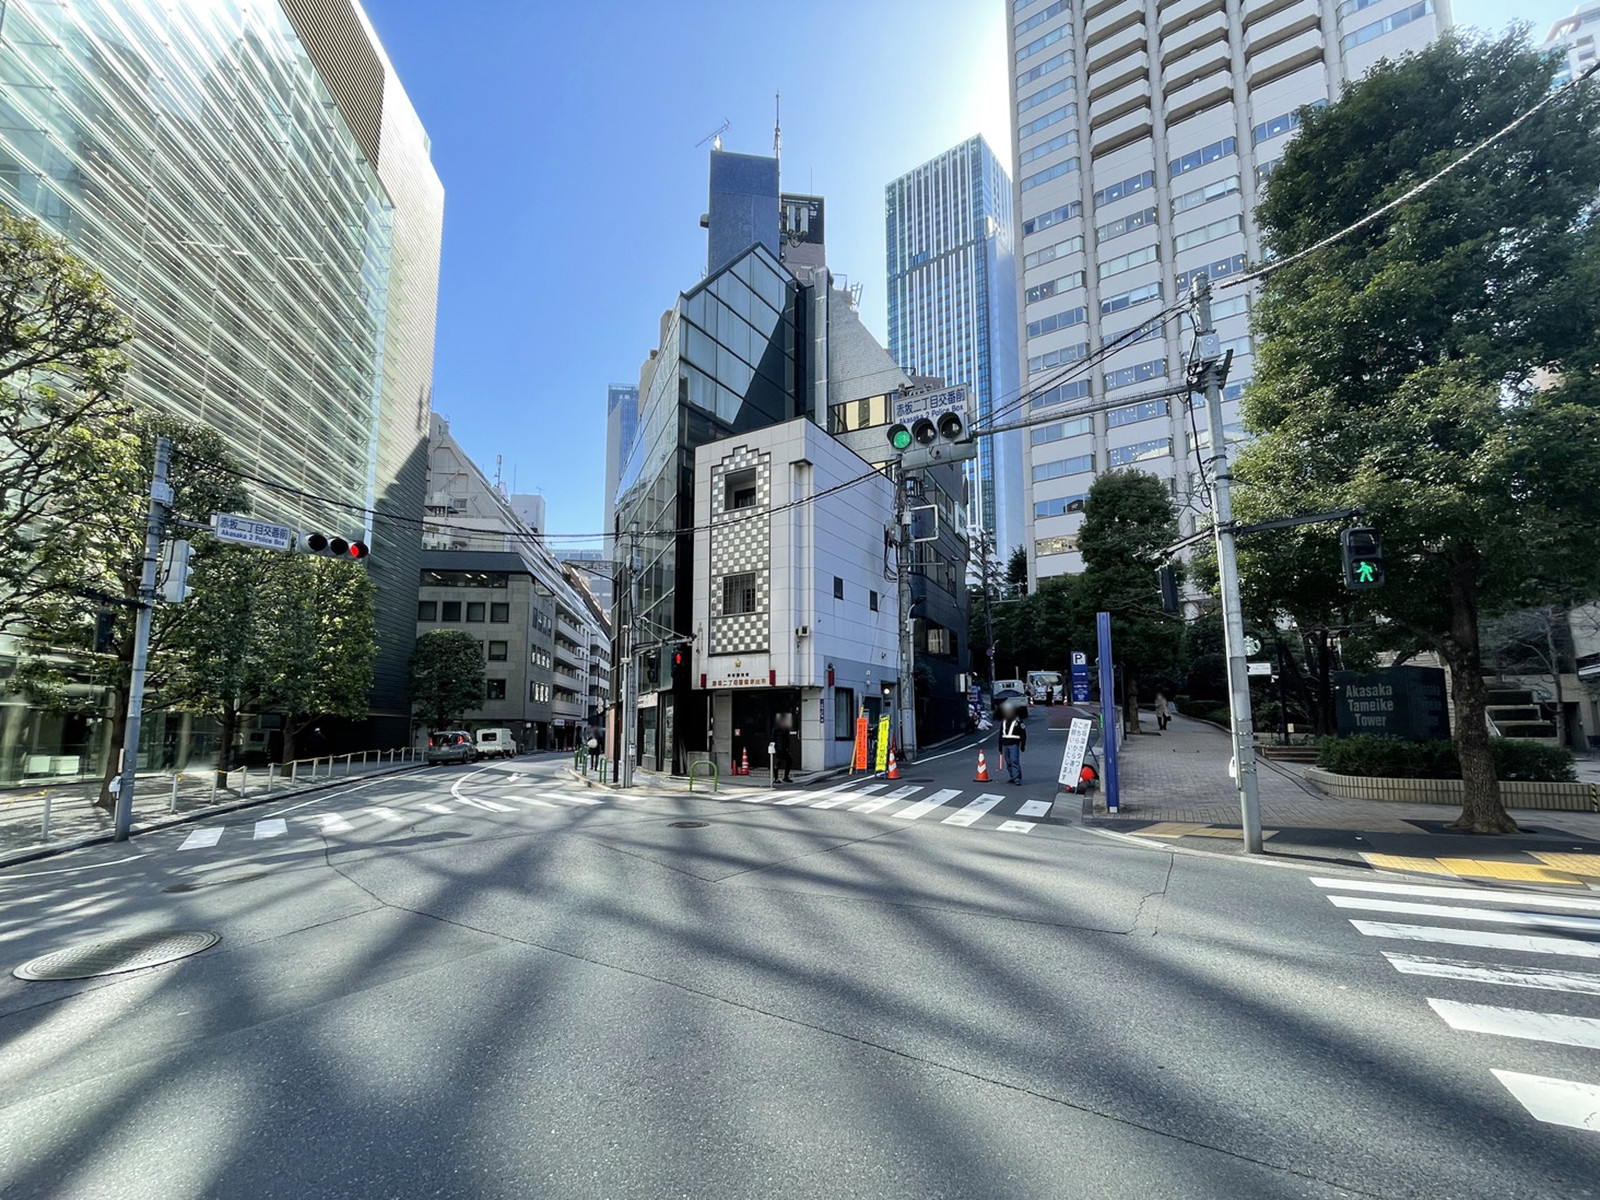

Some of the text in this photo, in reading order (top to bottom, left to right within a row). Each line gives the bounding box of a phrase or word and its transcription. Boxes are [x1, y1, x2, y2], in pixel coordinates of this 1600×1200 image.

[897, 388, 965, 416] 赤坂二丁目交番前
[952, 404, 964, 412] Box
[220, 517, 288, 540] 赤坂二丁目交番前
[222, 529, 247, 539] Akasaka
[255, 535, 273, 544] Police
[1345, 683, 1393, 698] Akasaka
[1347, 699, 1394, 712] Tameike
[1354, 713, 1387, 727] Tower
